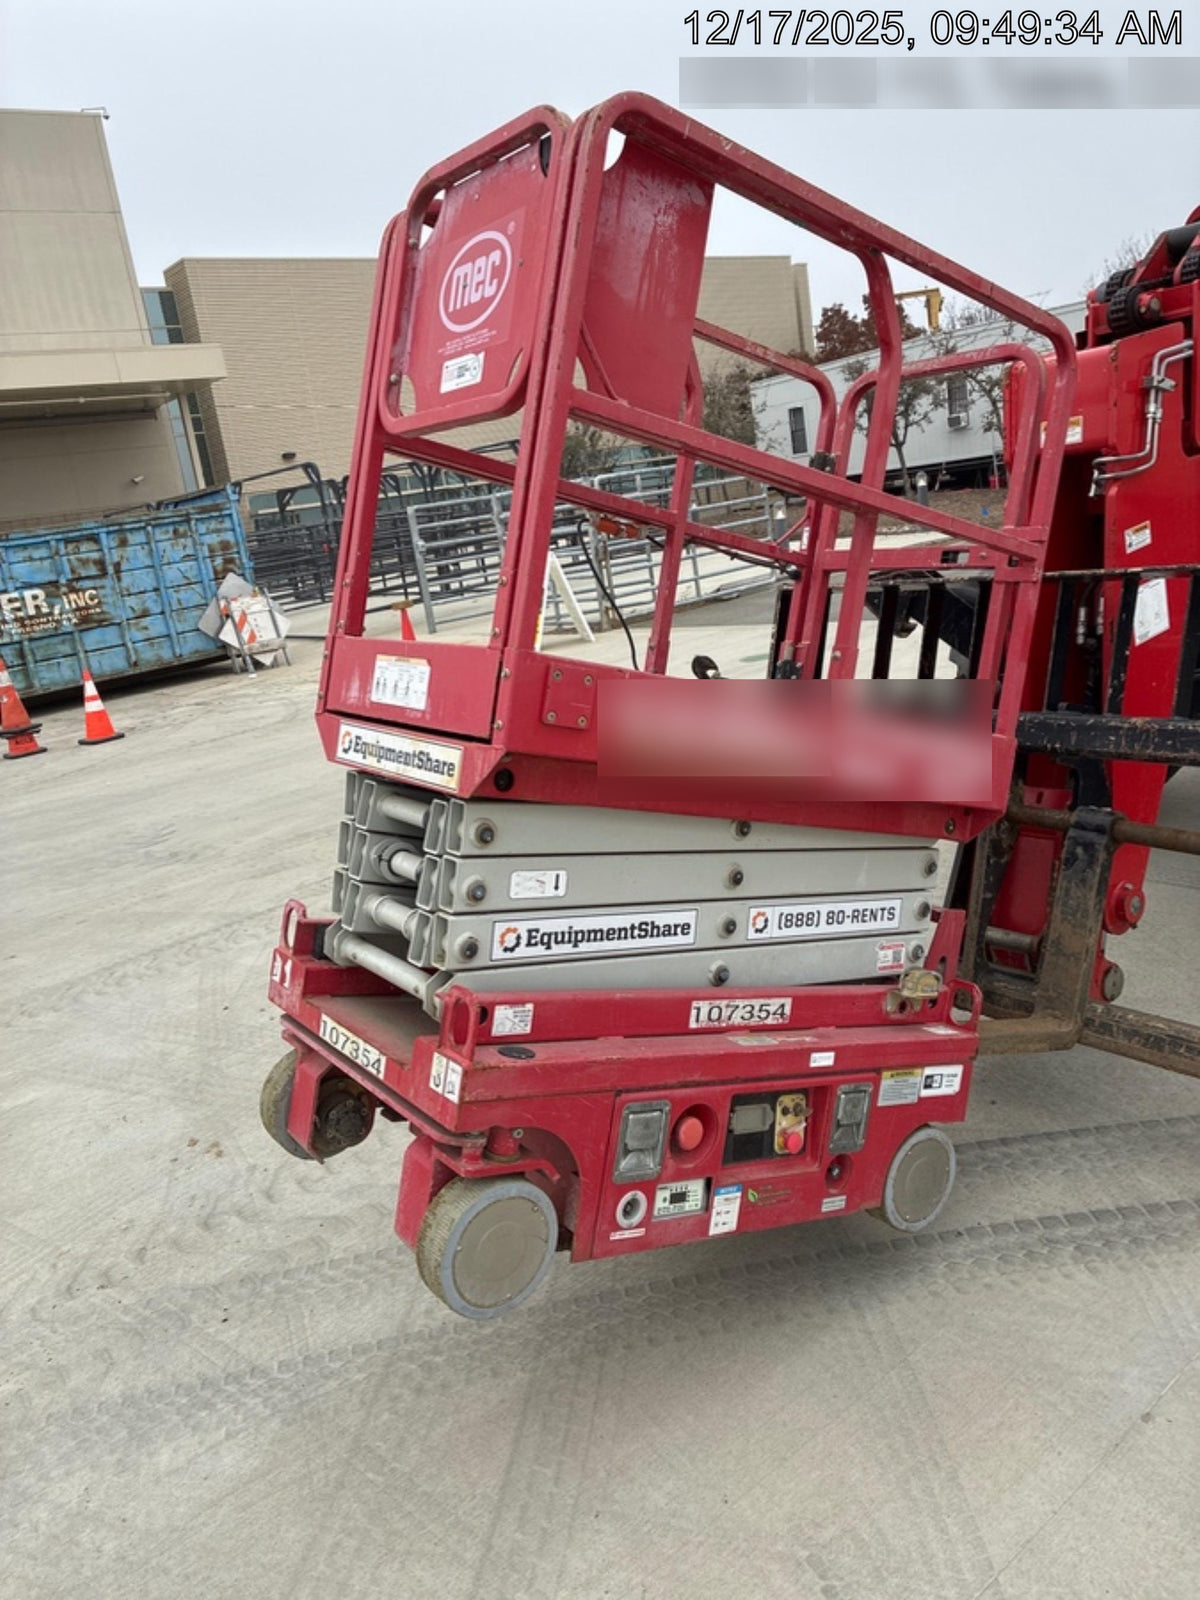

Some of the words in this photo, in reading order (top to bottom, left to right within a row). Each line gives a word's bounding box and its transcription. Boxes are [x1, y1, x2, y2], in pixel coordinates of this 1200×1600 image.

[62, 589, 99, 609] INC
[353, 734, 456, 777] EquipmentShare
[777, 910, 821, 930] (888)
[826, 906, 896, 926] 80-RENTS
[525, 920, 691, 950] EquipmentShare
[693, 1003, 787, 1024] 107354
[320, 1018, 383, 1077] 107354
